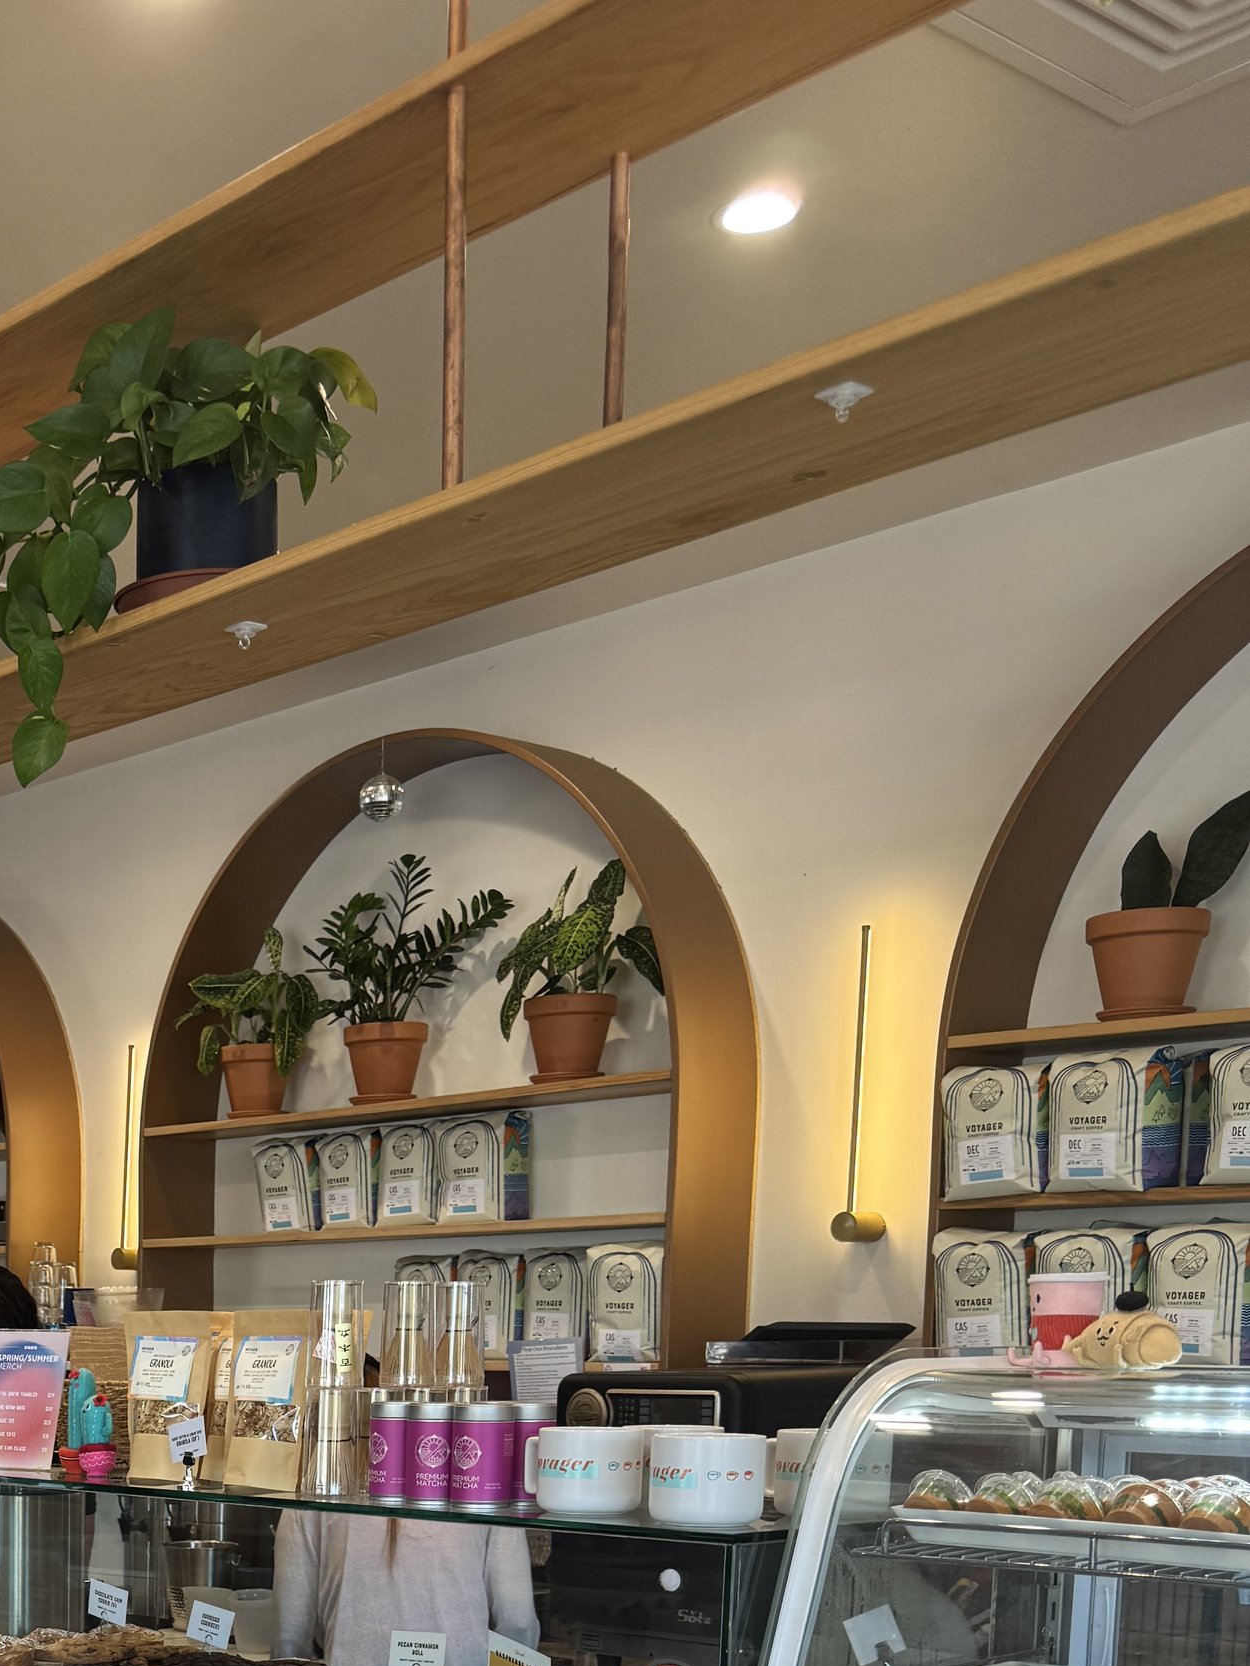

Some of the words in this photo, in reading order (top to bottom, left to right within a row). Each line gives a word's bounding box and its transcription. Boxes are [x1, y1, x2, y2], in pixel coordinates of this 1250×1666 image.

[1069, 1116, 1107, 1125] VOYAGER
[966, 1123, 1003, 1133] VOYAGER
[1232, 1126, 1247, 1137] DEC
[1068, 1139, 1082, 1150] DEC
[966, 1145, 980, 1155] DEC
[390, 1168, 414, 1176] VOYAGER
[453, 1167, 479, 1175] VOYAGER
[1166, 1291, 1206, 1301] VOYAGER
[605, 1302, 635, 1310] VOYAGER
[955, 1298, 993, 1307] VOYAGER
[536, 1316, 546, 1324] CAS
[955, 1322, 968, 1332] CAS
[605, 1333, 615, 1342] CAS
[150, 1358, 174, 1368] GRANOLA
[252, 1359, 277, 1369] GRANOLA
[414, 1642, 439, 1650] CINNAMON
